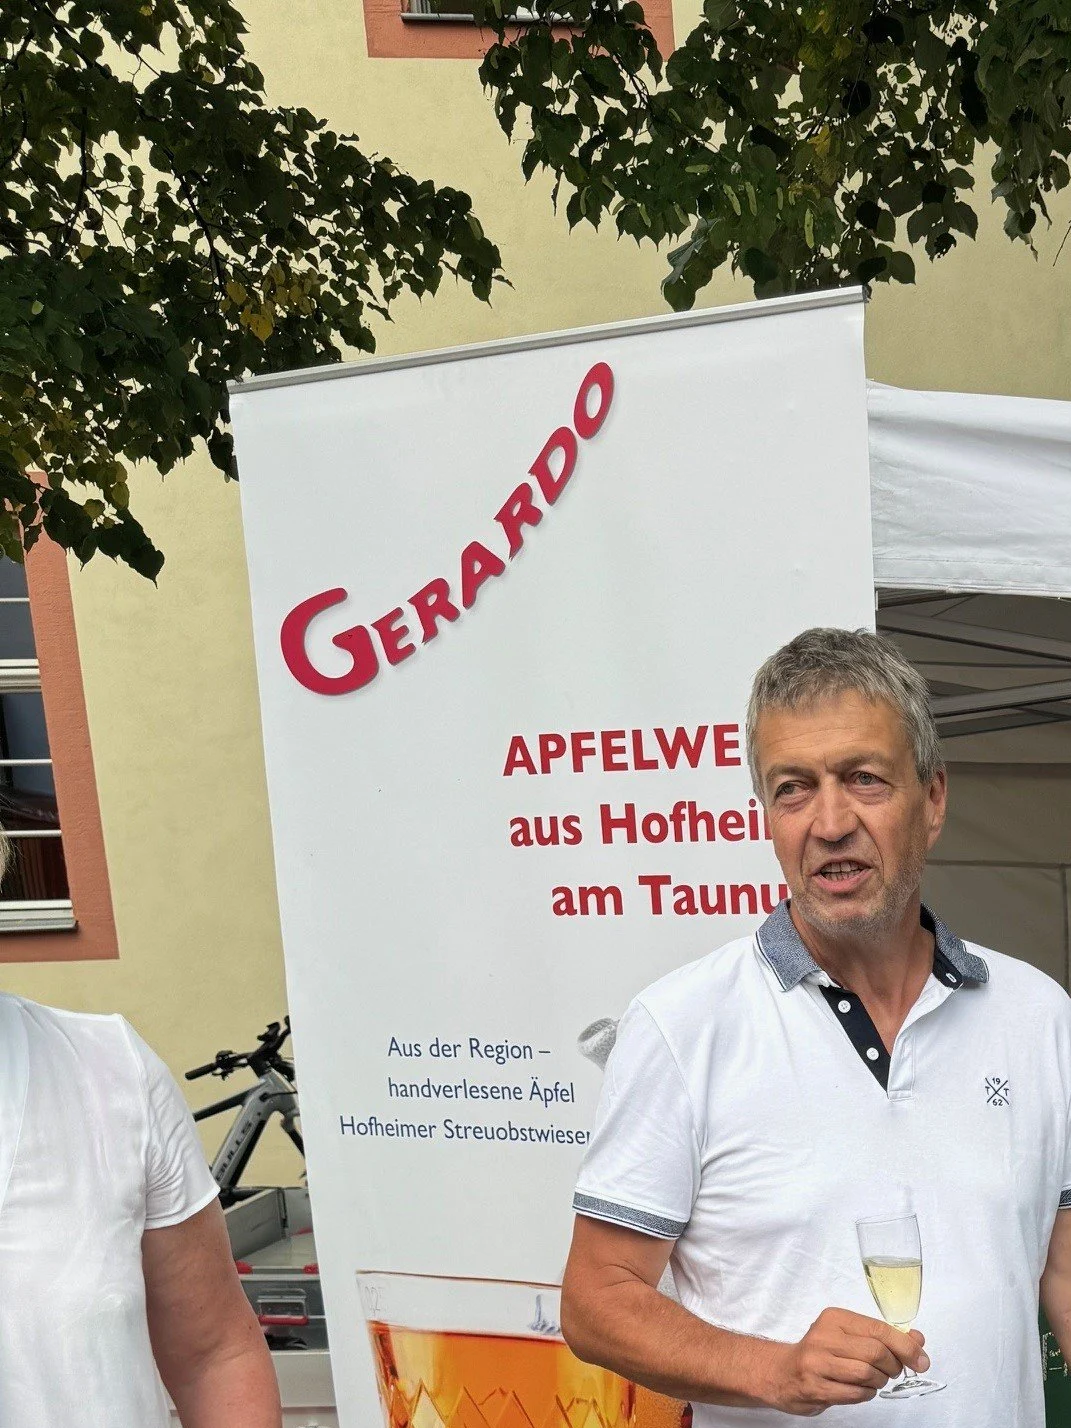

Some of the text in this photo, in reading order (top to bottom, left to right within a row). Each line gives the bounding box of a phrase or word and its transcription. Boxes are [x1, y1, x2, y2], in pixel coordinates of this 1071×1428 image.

[280, 361, 616, 697] GERARDO
[503, 724, 741, 776] APFELWE
[509, 815, 583, 846] aus
[552, 874, 788, 916] am Taunu
[387, 1037, 421, 1058] Aus
[429, 1037, 461, 1059] der
[469, 1037, 533, 1065] Region
[388, 1077, 575, 1107] handverlesene Äpfel
[339, 1115, 437, 1139] Hofheimer
